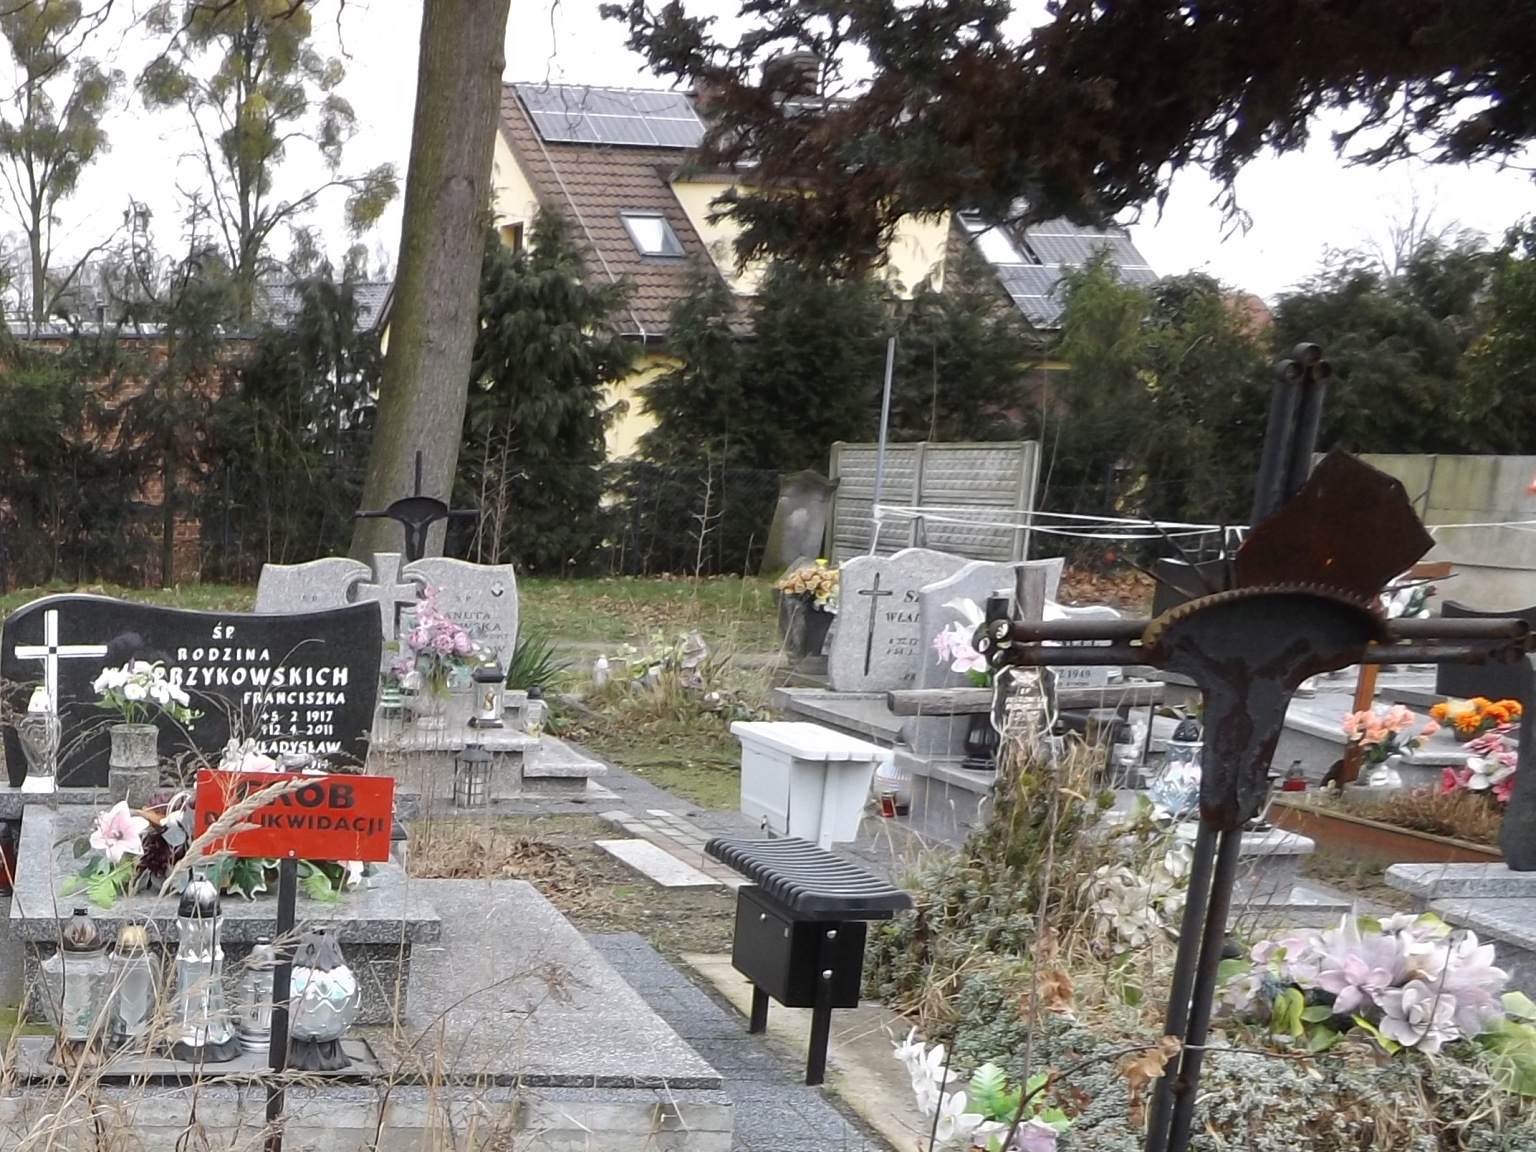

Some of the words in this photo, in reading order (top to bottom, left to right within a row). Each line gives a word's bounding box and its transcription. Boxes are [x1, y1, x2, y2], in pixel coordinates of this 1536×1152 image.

[444, 611, 491, 620] ANUTA
[177, 648, 270, 662] RODZINA
[244, 692, 346, 705] FRANCISZKA
[306, 710, 334, 722] 1917
[306, 724, 333, 735] 2011
